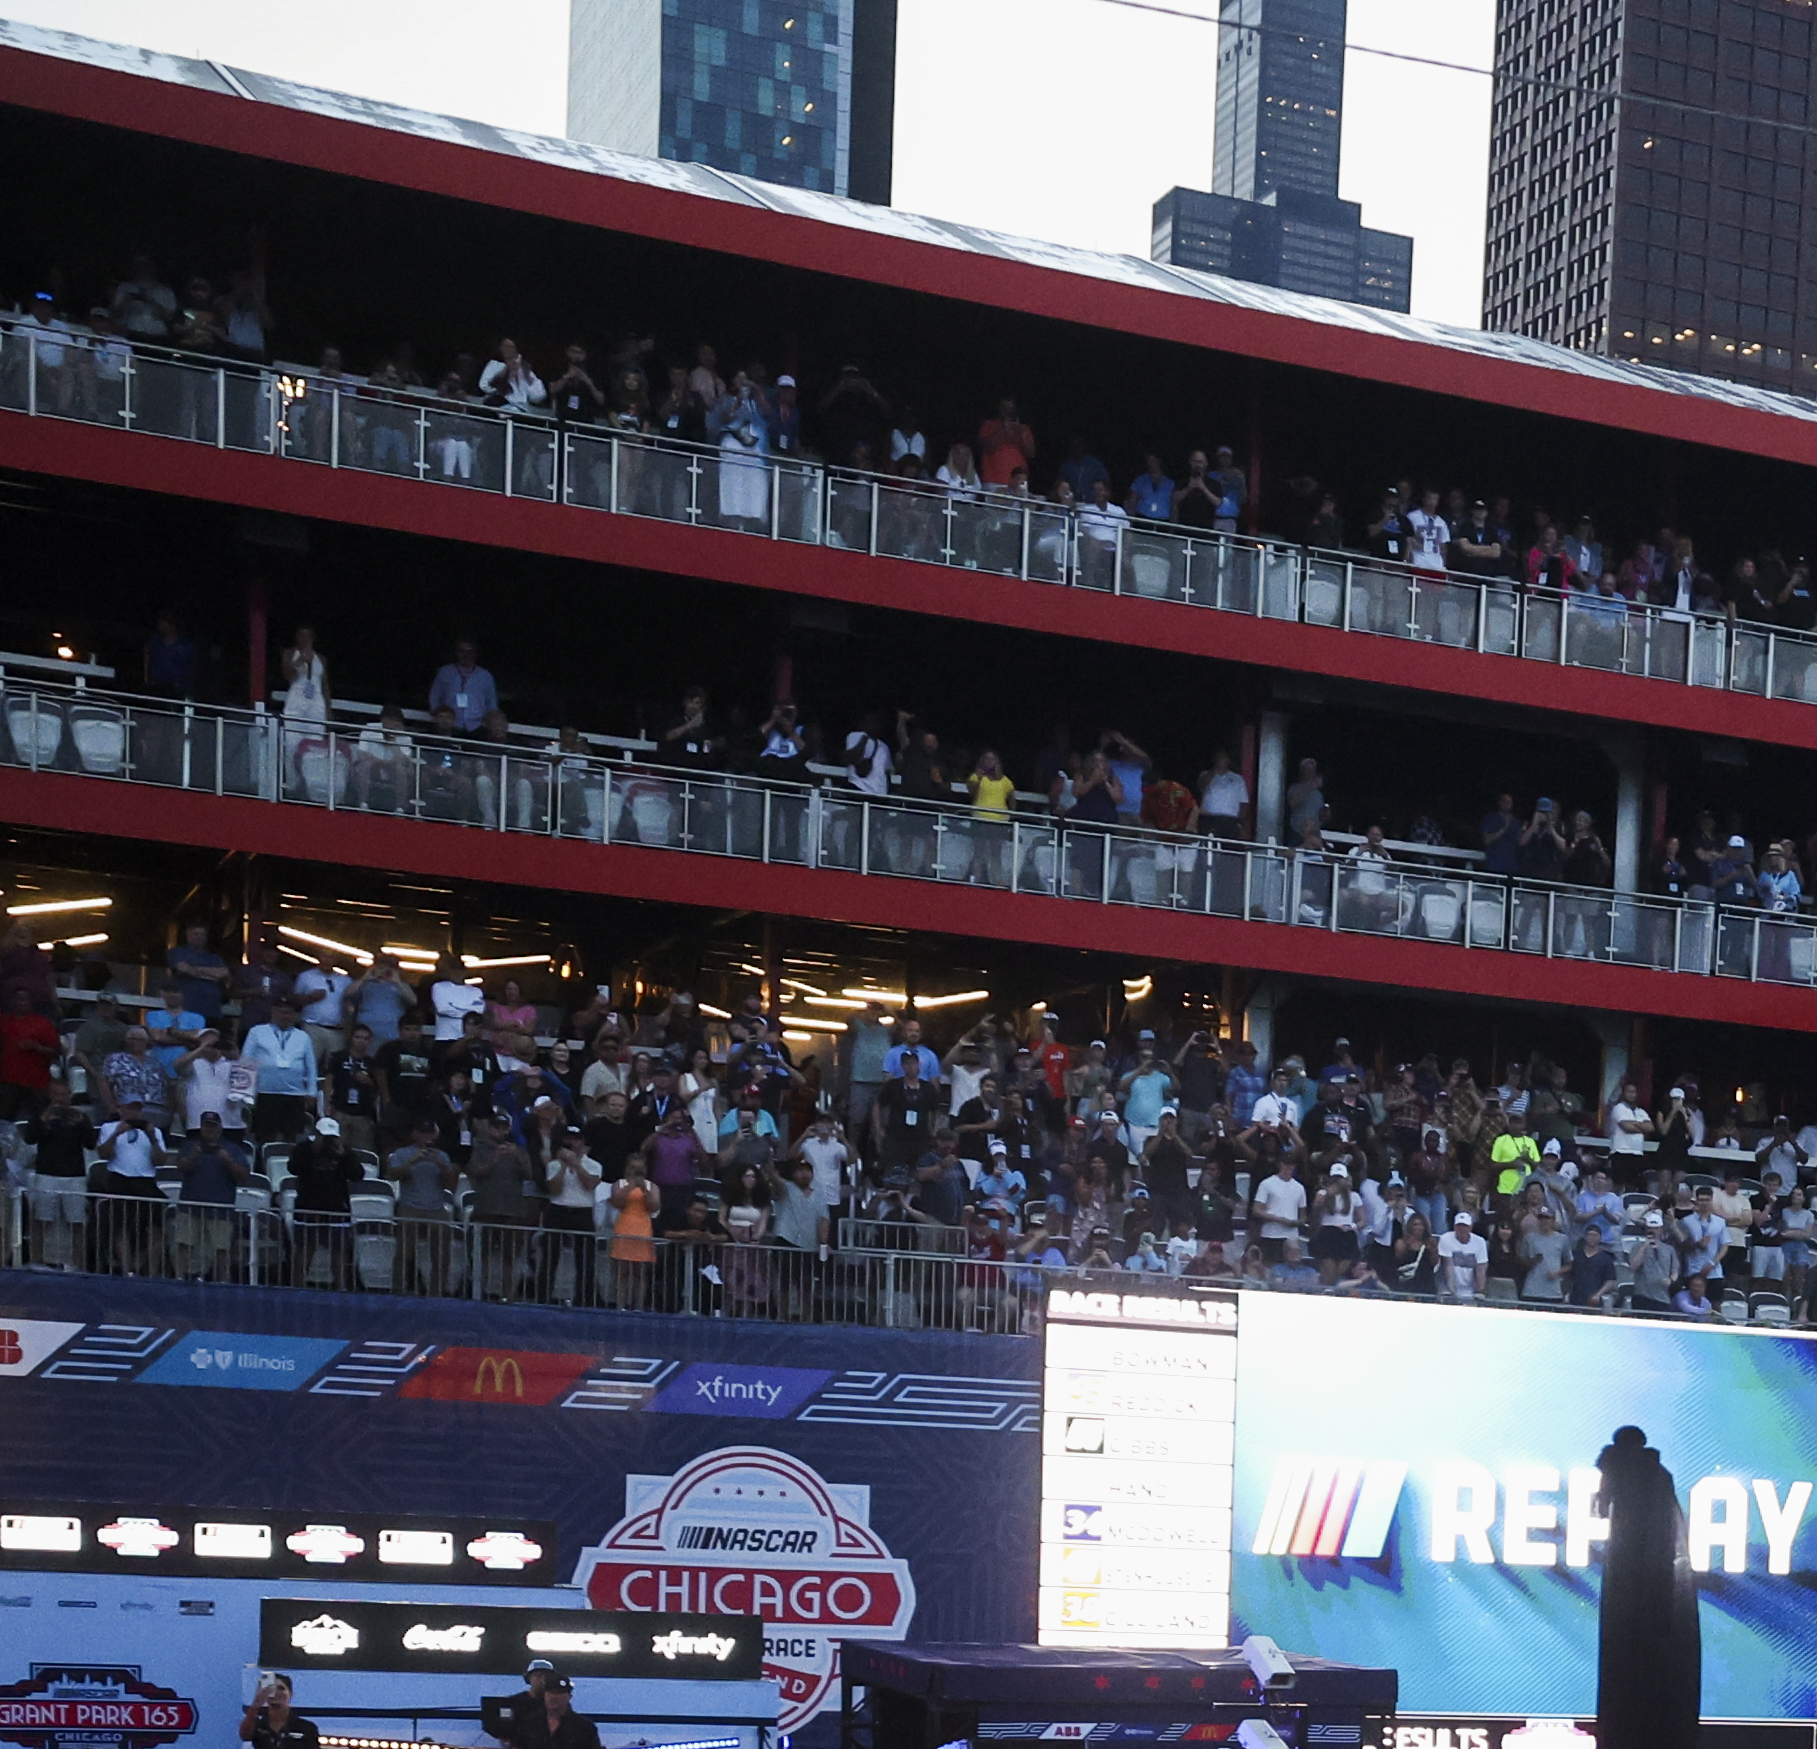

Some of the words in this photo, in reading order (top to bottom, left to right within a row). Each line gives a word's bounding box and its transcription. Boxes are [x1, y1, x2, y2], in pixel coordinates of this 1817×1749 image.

[238, 1353, 296, 1372] Illinois
[696, 1376, 783, 1406] xfinity
[1430, 1461, 1814, 1576] REPAY
[709, 1526, 818, 1554] NASCAR
[620, 1570, 873, 1620] CHICAGO
[0, 1704, 69, 1726] GRANT
[77, 1704, 136, 1726] PARK
[142, 1705, 181, 1727] 165
[54, 1732, 124, 1743] CHICAGO
[1054, 1726, 1081, 1738] ABB
